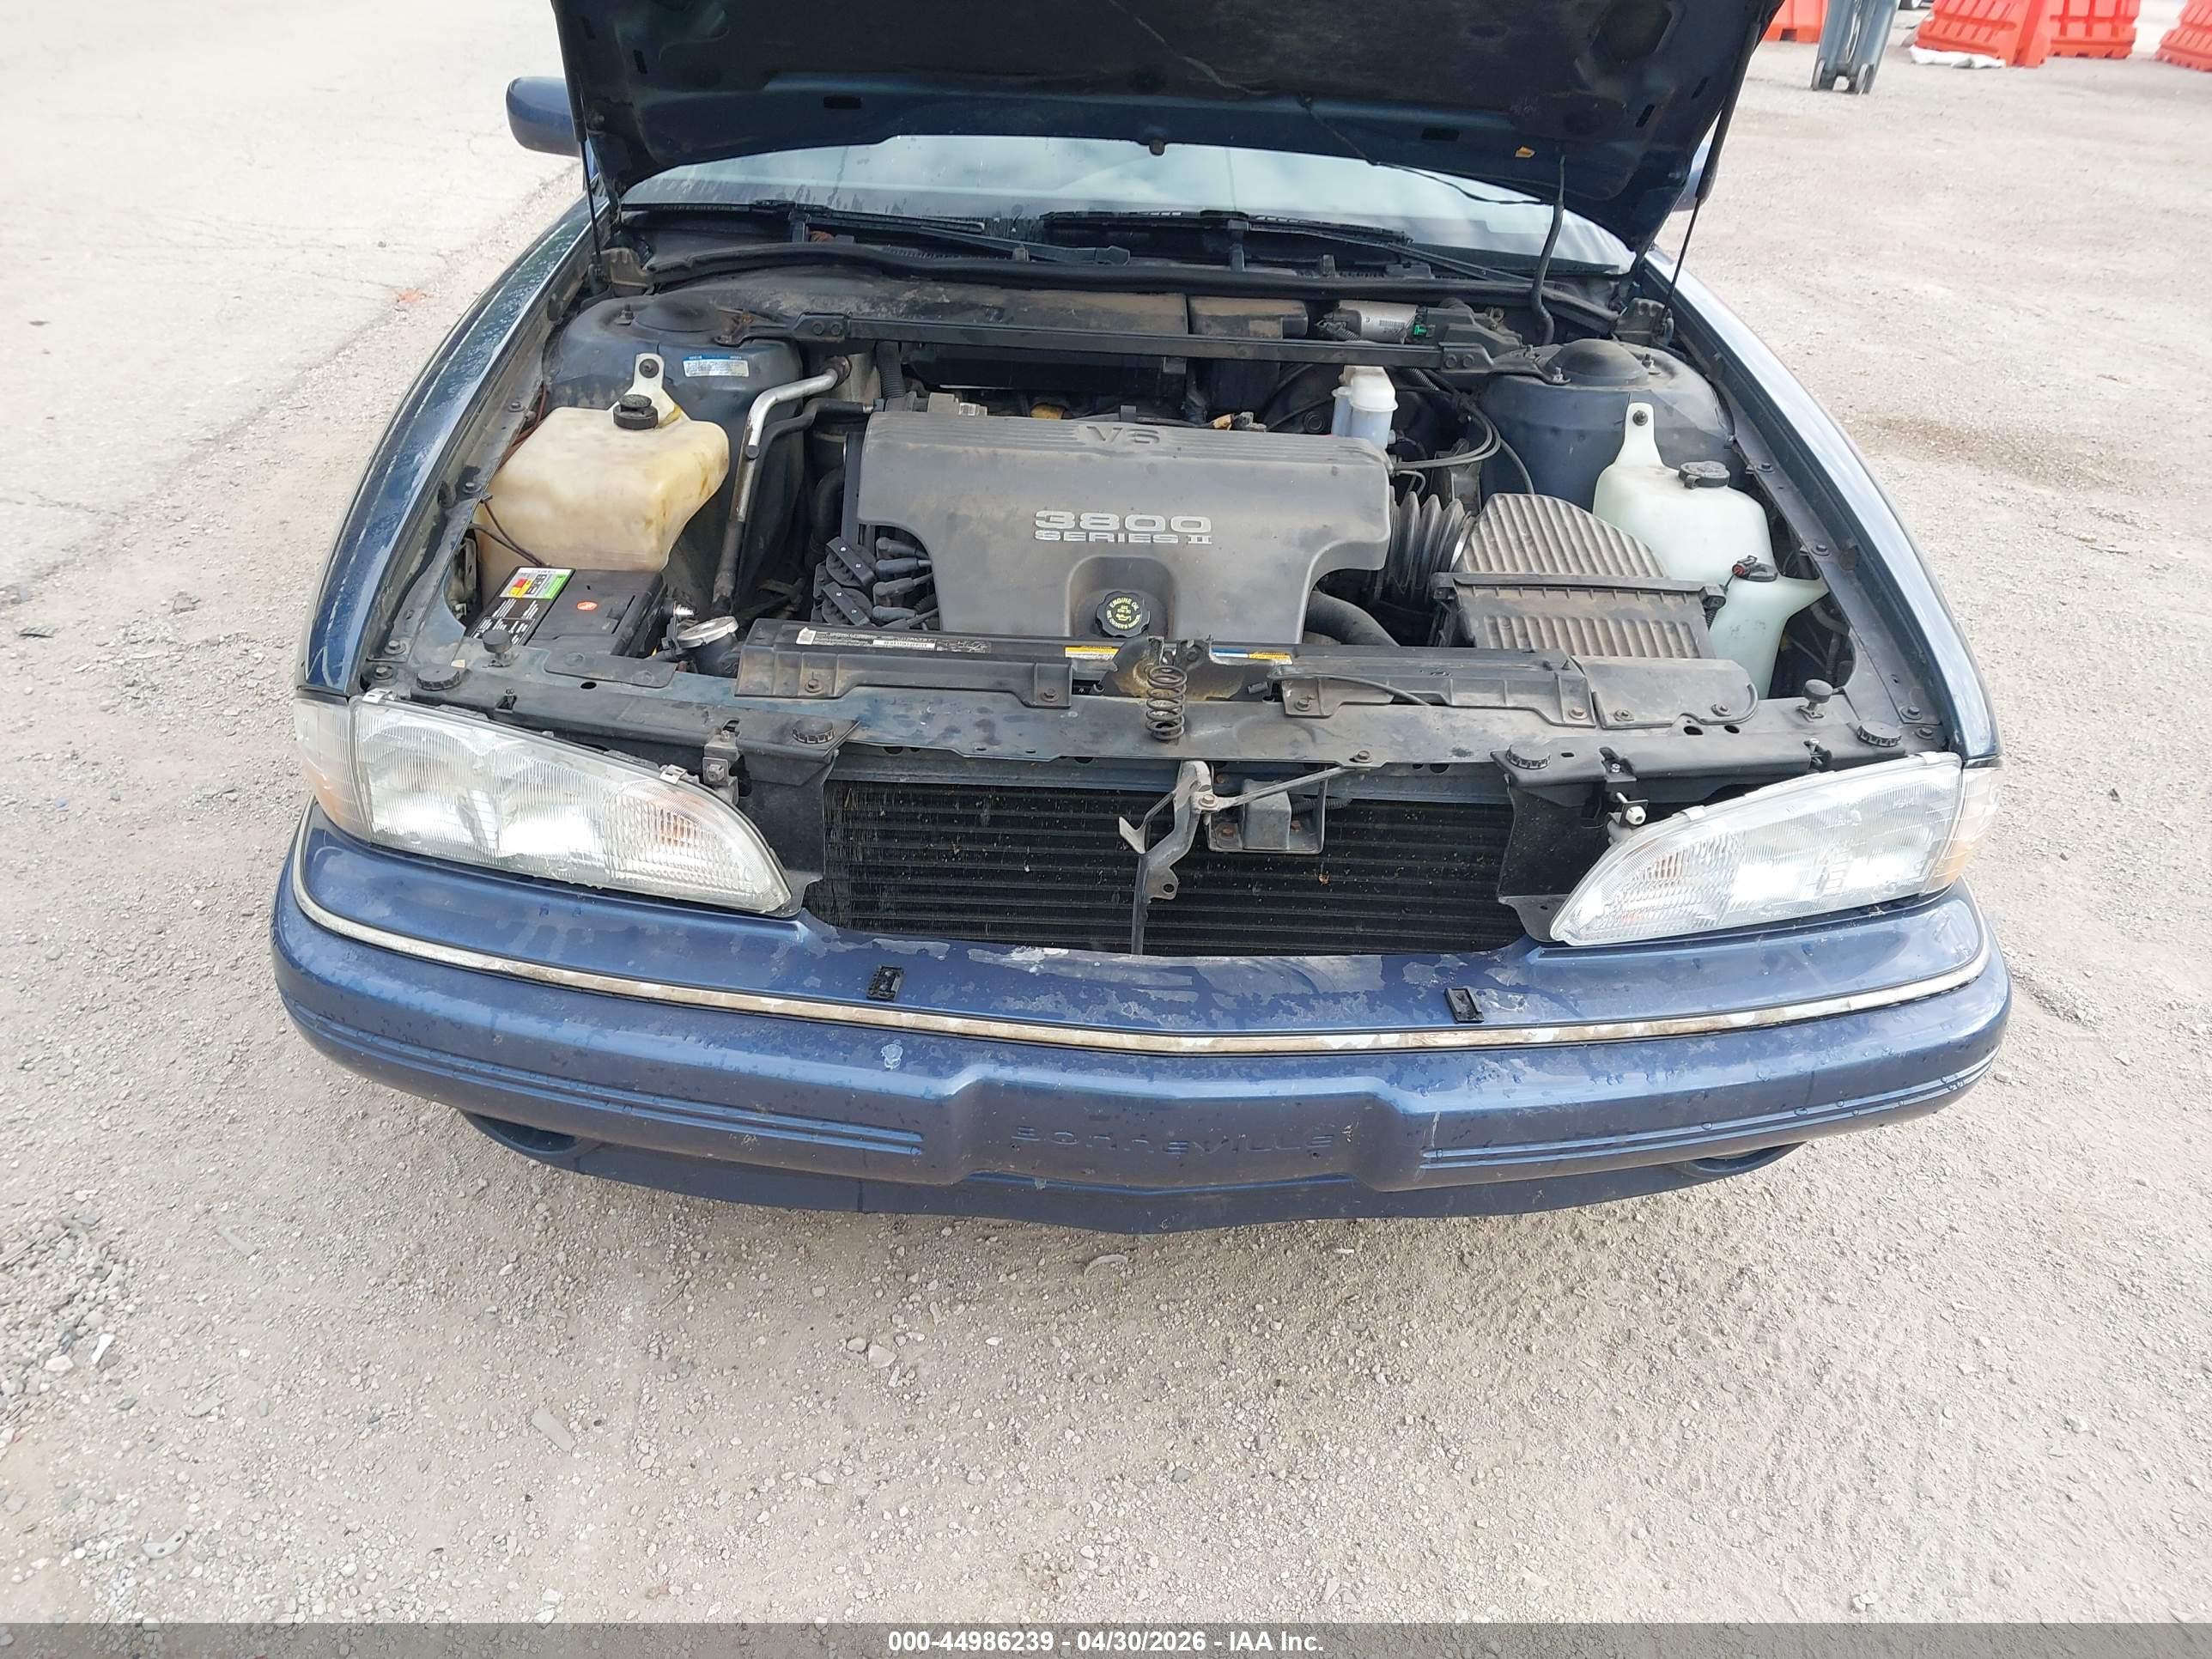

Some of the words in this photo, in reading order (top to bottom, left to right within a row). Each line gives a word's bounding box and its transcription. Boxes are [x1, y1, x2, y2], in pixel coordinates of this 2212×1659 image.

[1085, 425, 1161, 445] V6
[1035, 510, 1212, 533] 3800
[1034, 529, 1179, 544] SERIES
[1187, 533, 1213, 544] II
